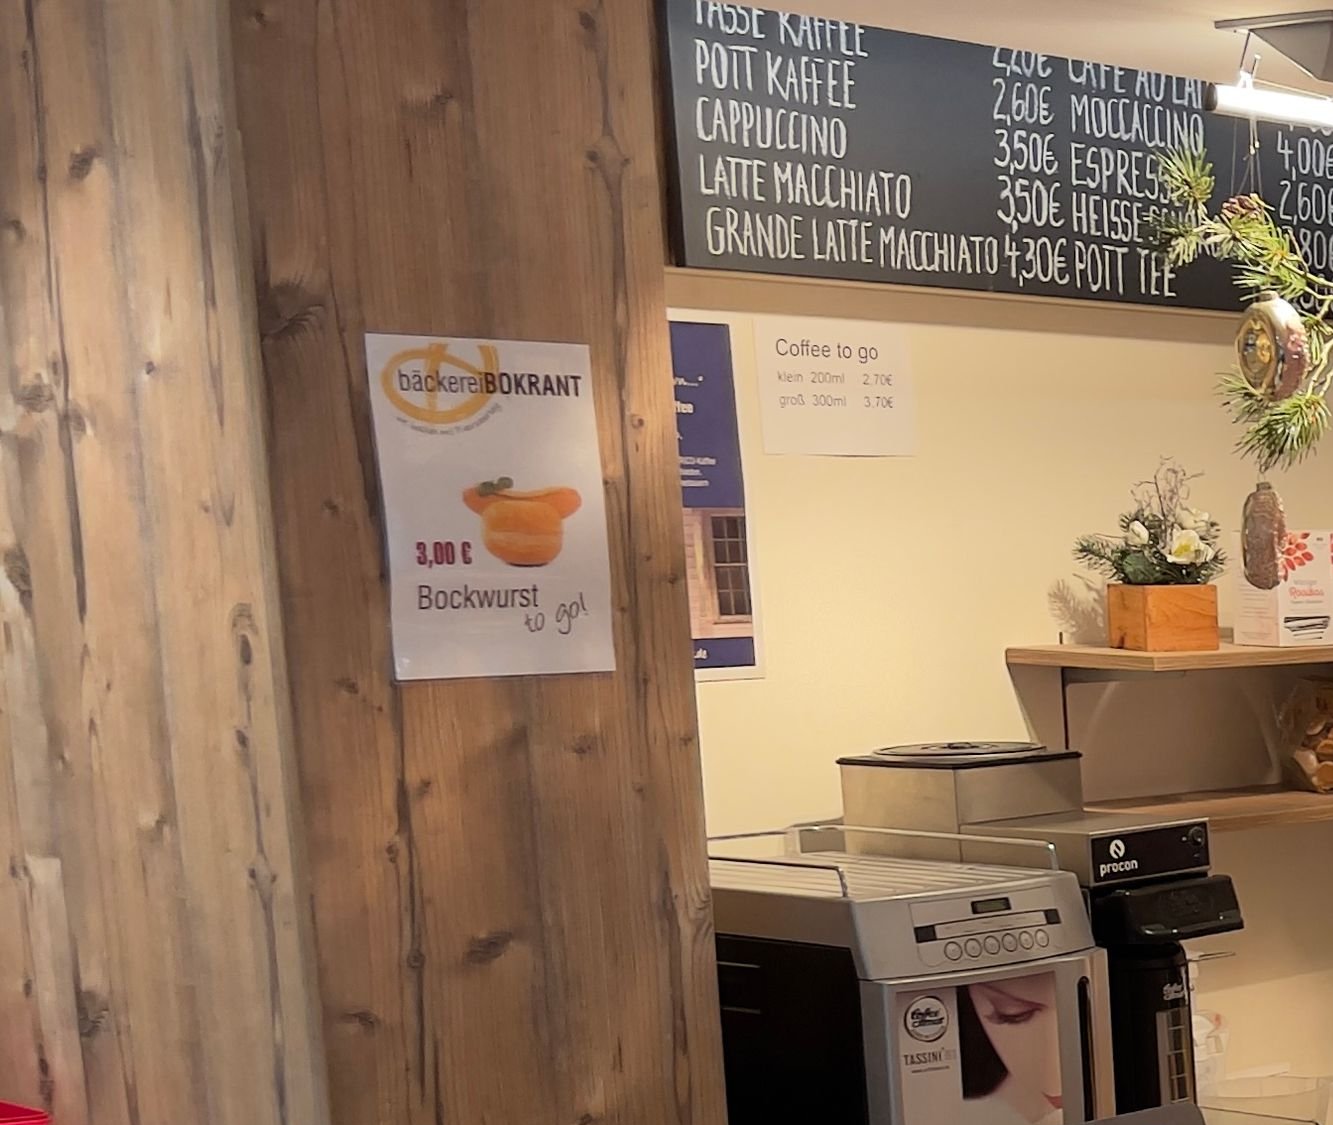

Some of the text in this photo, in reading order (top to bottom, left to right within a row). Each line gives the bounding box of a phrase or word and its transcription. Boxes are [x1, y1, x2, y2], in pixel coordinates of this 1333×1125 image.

[694, 38, 856, 109] POTT KAFFEE
[992, 79, 1054, 127] 2,60€
[1070, 94, 1205, 157] MOCCACCINO
[696, 97, 847, 159] CAPPUCCINO
[994, 129, 1058, 176] 3,50€
[700, 154, 912, 219] LATTE MACCHIATO
[997, 175, 1065, 234] 3,50€
[706, 206, 999, 275] GRANDE LATTE MACCHIATO
[1004, 233, 1069, 287] 4,30€
[1074, 240, 1177, 297] POTT TEE
[775, 338, 878, 364] Coffee to go
[777, 371, 804, 384] klein
[810, 371, 845, 384] 200ml
[779, 394, 805, 409] groß
[812, 394, 846, 407] 300ml
[416, 541, 456, 568] 3,00
[417, 584, 538, 610] Bockwurst
[524, 592, 590, 635] to go!
[1100, 856, 1138, 877] procon
[904, 1050, 943, 1066] TASSINI
